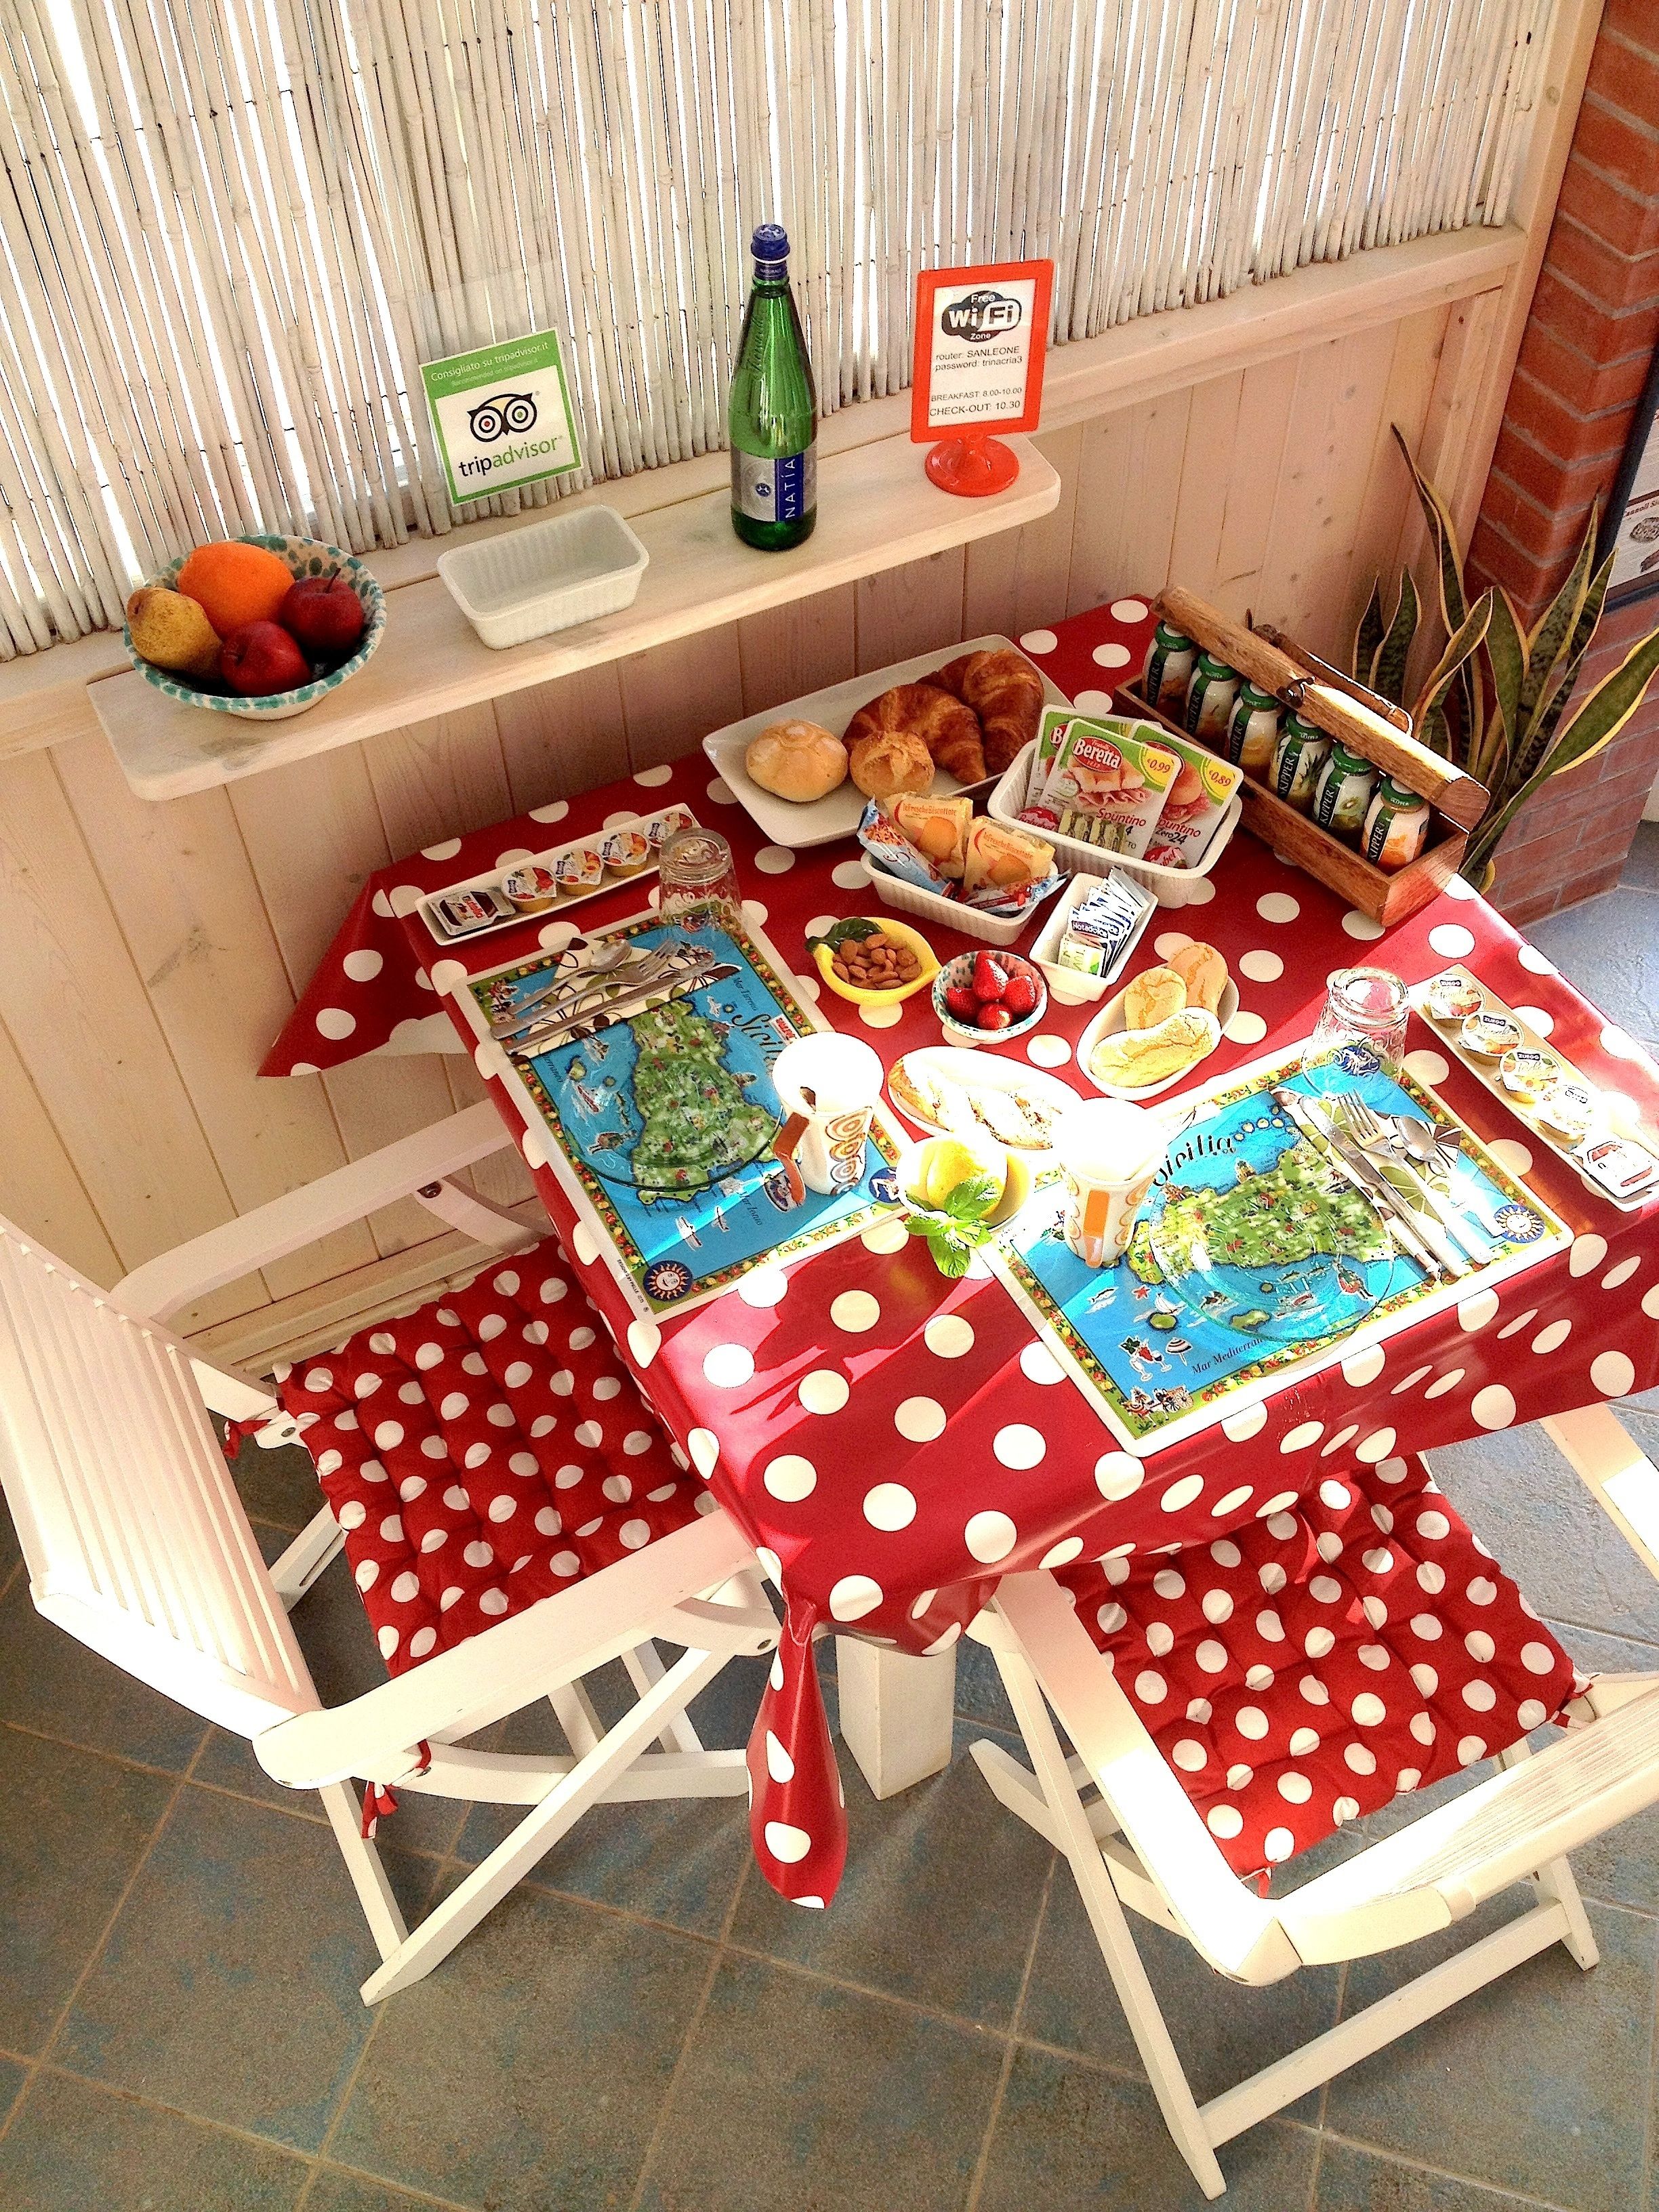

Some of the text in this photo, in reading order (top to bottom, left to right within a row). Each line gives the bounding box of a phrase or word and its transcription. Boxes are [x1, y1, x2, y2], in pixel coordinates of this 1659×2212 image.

[970, 293, 996, 304] Free
[970, 332, 991, 340] Zone
[430, 341, 548, 381] Consigliato su tripadvisor.it
[935, 346, 1020, 361] router: SANLEONE
[935, 356, 1023, 372] password: trinacria3
[996, 400, 1021, 411] 10.30
[459, 437, 558, 477] tripadvisor
[1072, 739, 1120, 769] Beretta
[1096, 808, 1147, 827] Spuntino
[1158, 818, 1202, 838] puntino
[1191, 1338, 1263, 1374] Mar Mediterran
